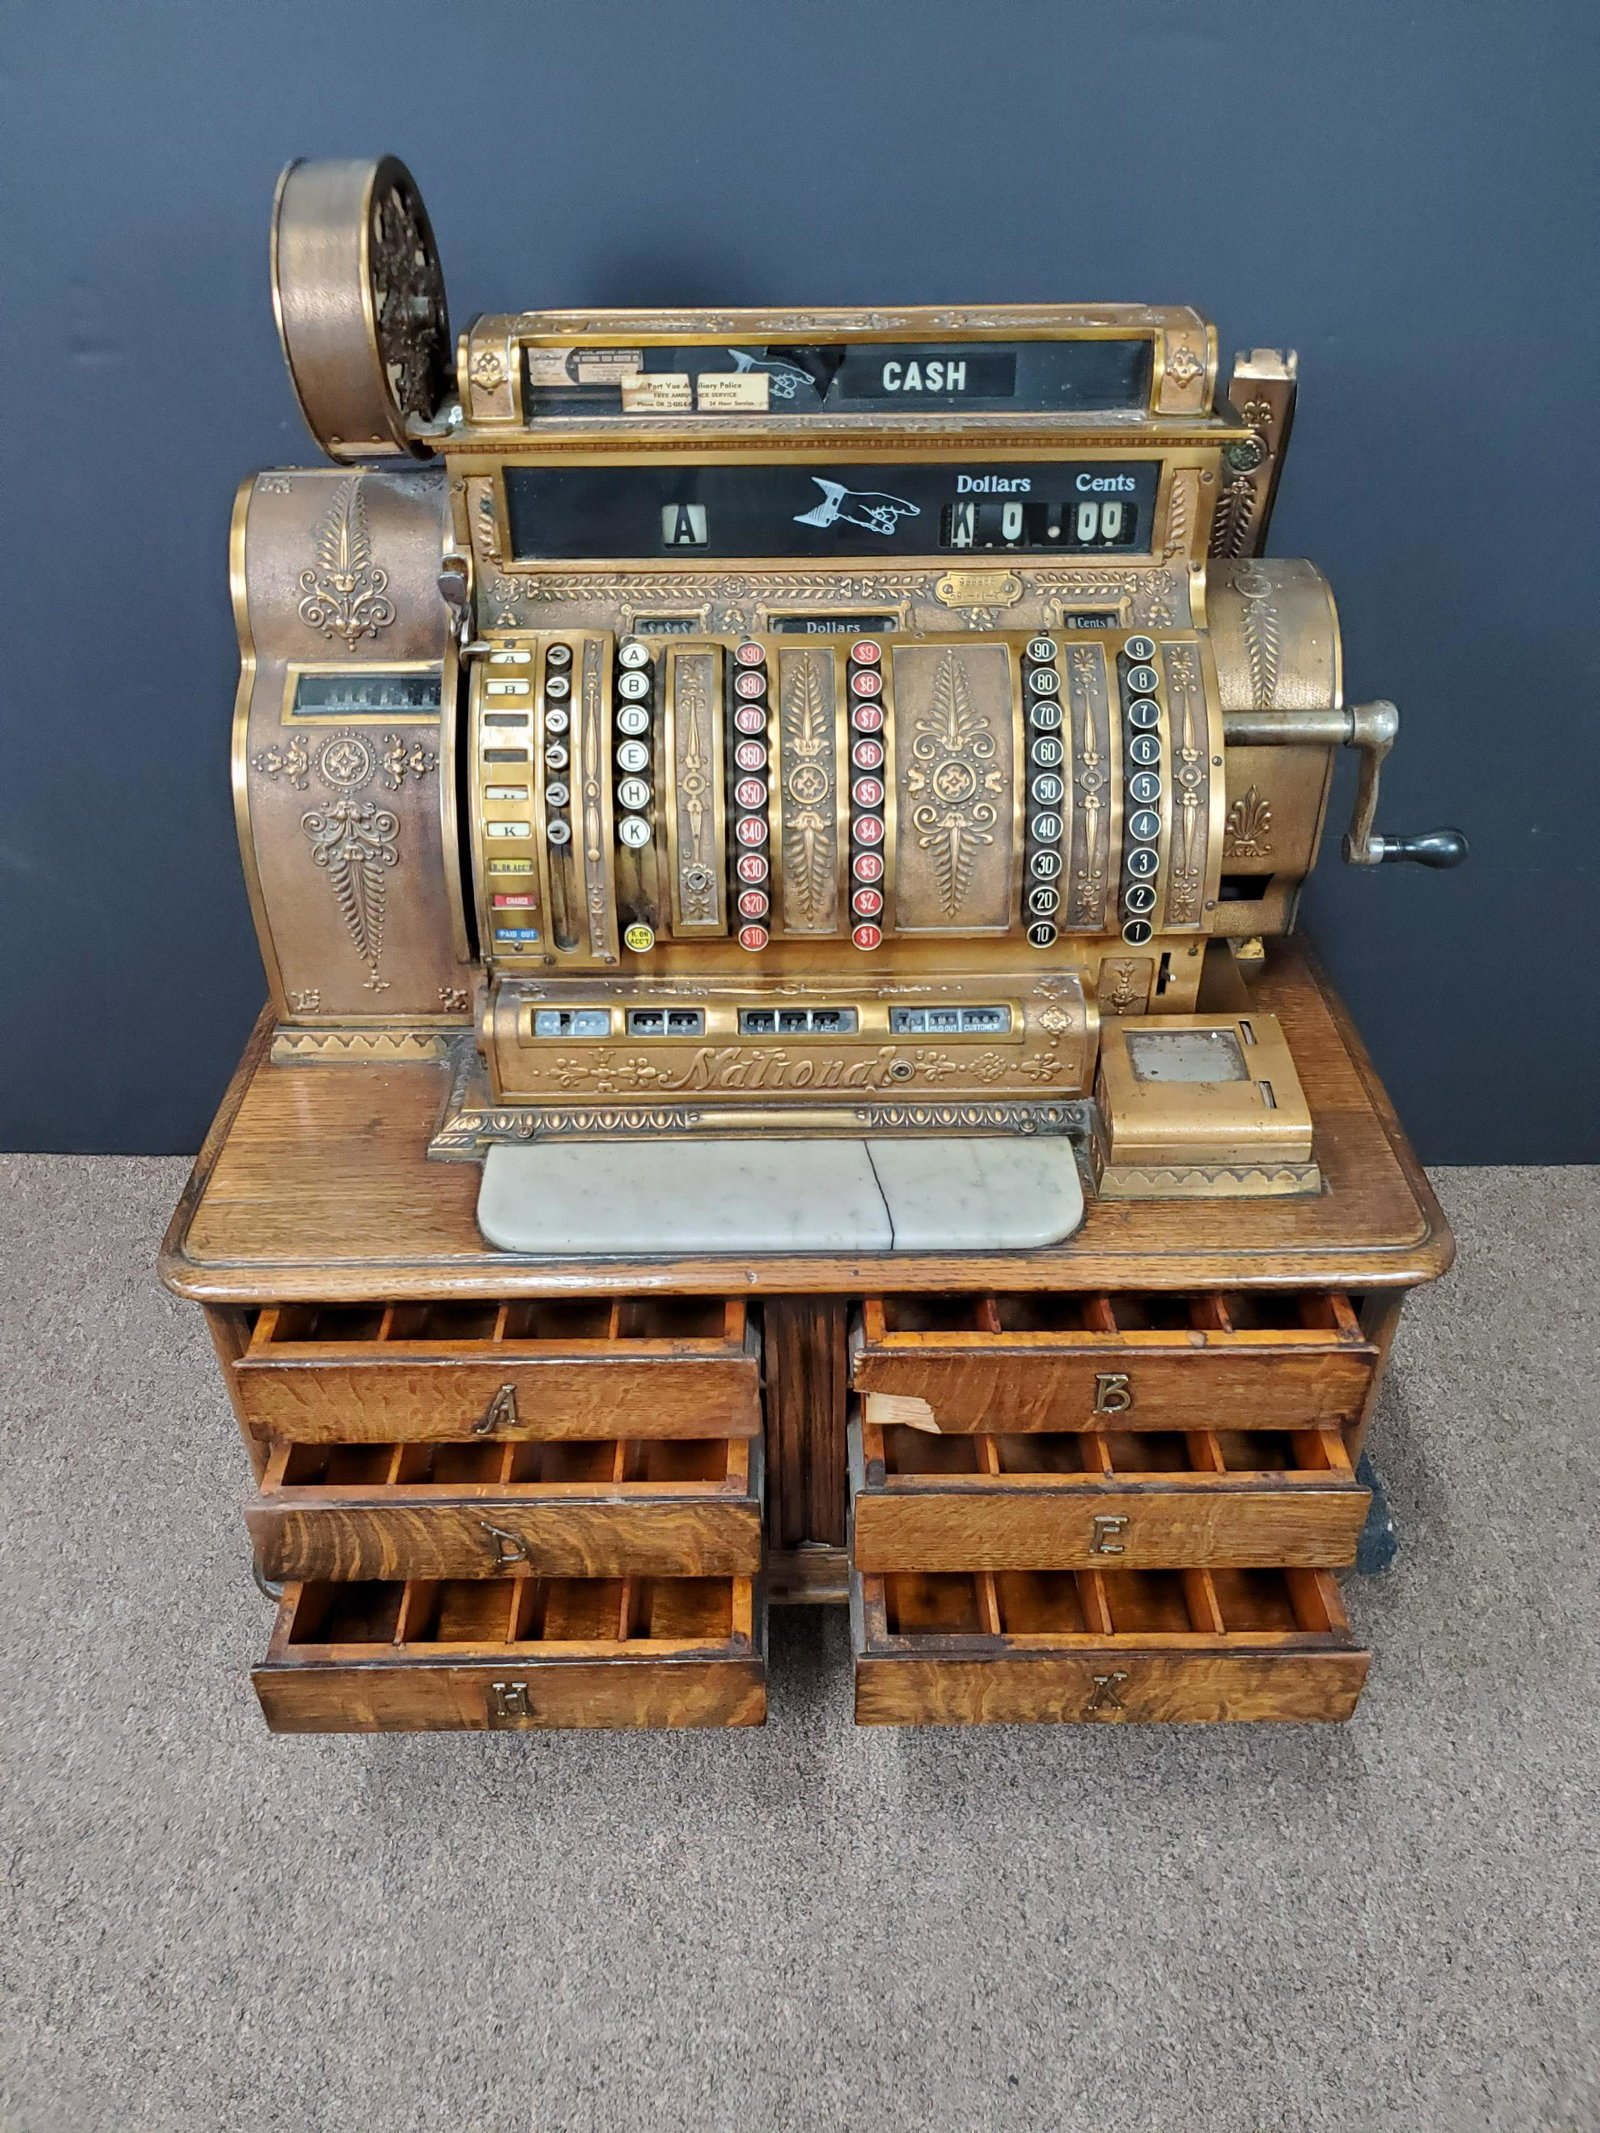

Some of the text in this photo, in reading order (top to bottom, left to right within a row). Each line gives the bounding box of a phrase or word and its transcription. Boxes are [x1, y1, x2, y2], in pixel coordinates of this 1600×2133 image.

[882, 361, 967, 391] CASH
[647, 382, 663, 390] Port
[666, 382, 681, 390] Vue
[719, 381, 743, 390] Police
[711, 391, 737, 399] SERVICE
[956, 473, 1136, 494] Dollars Cents
[673, 503, 697, 543] A
[806, 621, 861, 634] Dollars
[1077, 617, 1106, 629] Cents
[628, 649, 640, 662] A
[741, 647, 760, 662] $90
[858, 646, 873, 661] $9
[1034, 643, 1050, 658] 90
[1136, 642, 1145, 656] 9
[628, 679, 639, 692] B
[741, 679, 760, 694] $80
[859, 676, 874, 693] $8
[1037, 674, 1053, 690] 80
[1138, 672, 1148, 688] 8
[628, 713, 639, 727] D
[740, 711, 761, 728] $70
[861, 709, 876, 728] $7
[1040, 708, 1054, 725] 70
[1140, 705, 1148, 723] 7
[628, 749, 638, 764] E
[741, 748, 760, 766] $60
[860, 745, 875, 764] $6
[1040, 742, 1056, 760] 60
[1142, 741, 1150, 759] 6
[628, 786, 640, 801] H
[741, 785, 760, 803] $50
[860, 782, 876, 801] $5
[1040, 780, 1056, 799] 50
[1141, 778, 1150, 797] 5
[630, 825, 641, 839] K
[741, 822, 761, 840] $40
[861, 821, 876, 839] $4
[1038, 818, 1055, 836] 40
[1139, 816, 1148, 834] 4
[742, 860, 762, 877] $30
[861, 860, 876, 877] $3
[1037, 856, 1053, 874] 30
[1139, 854, 1148, 872] 3
[505, 896, 529, 905] CHARGE
[744, 896, 763, 912] $20
[860, 894, 875, 910] $2
[1036, 892, 1052, 909] 20
[1136, 889, 1144, 907] 2
[500, 930, 535, 938] PAID OUT
[743, 931, 762, 945] $10
[861, 929, 873, 944] $1
[1036, 926, 1050, 942] 10
[1135, 924, 1140, 940] 1
[658, 1045, 897, 1091] National
[1091, 1373, 1133, 1415] B
[474, 1383, 519, 1435] A
[1088, 1514, 1129, 1554] E
[492, 1680, 534, 1717] H
[1086, 1671, 1129, 1711] K
